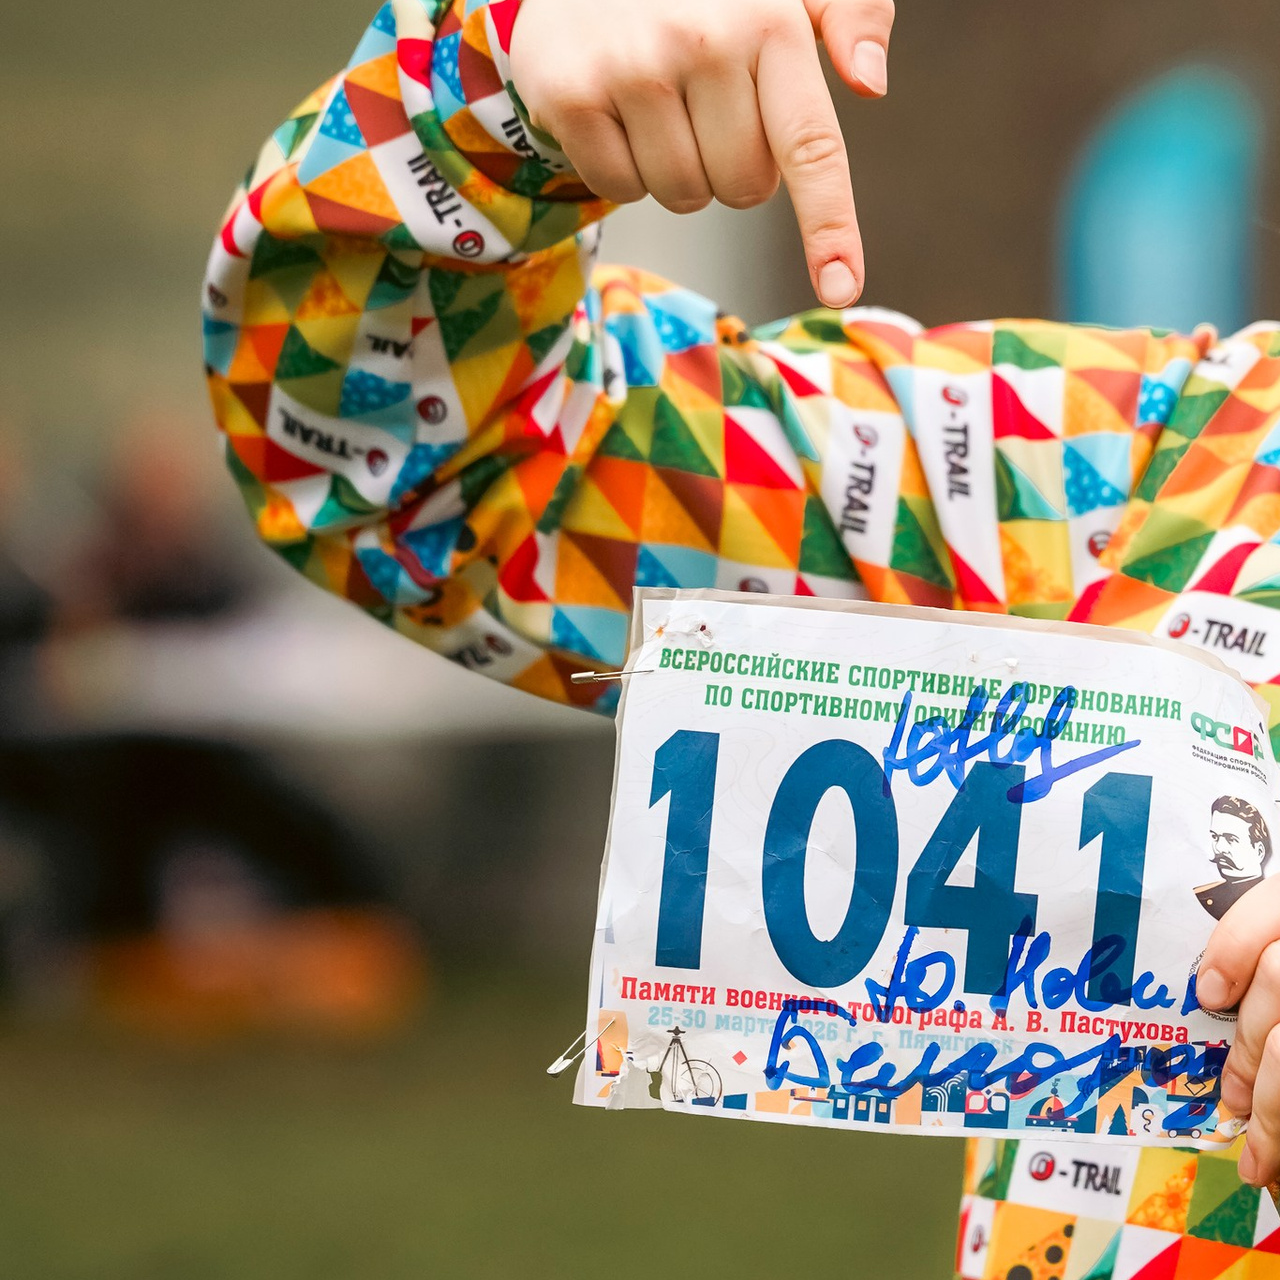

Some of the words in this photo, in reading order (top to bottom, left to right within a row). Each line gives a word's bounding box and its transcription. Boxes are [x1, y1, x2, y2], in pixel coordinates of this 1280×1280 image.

[658, 647, 841, 684] ВСЕРОССИЙСКИЕ
[848, 664, 1002, 700] СПОРТИВНЫЕ
[704, 684, 733, 707] ПО
[740, 688, 908, 723] СПОРТИВНОМУ
[649, 729, 1154, 1007] 1041
[620, 976, 716, 1006] Памяти
[725, 987, 839, 1018] военного
[847, 1000, 983, 1033] топографа
[1026, 1010, 1049, 1033] В.
[1059, 1010, 1188, 1044] Пастухова
[647, 1006, 707, 1029] 25-30
